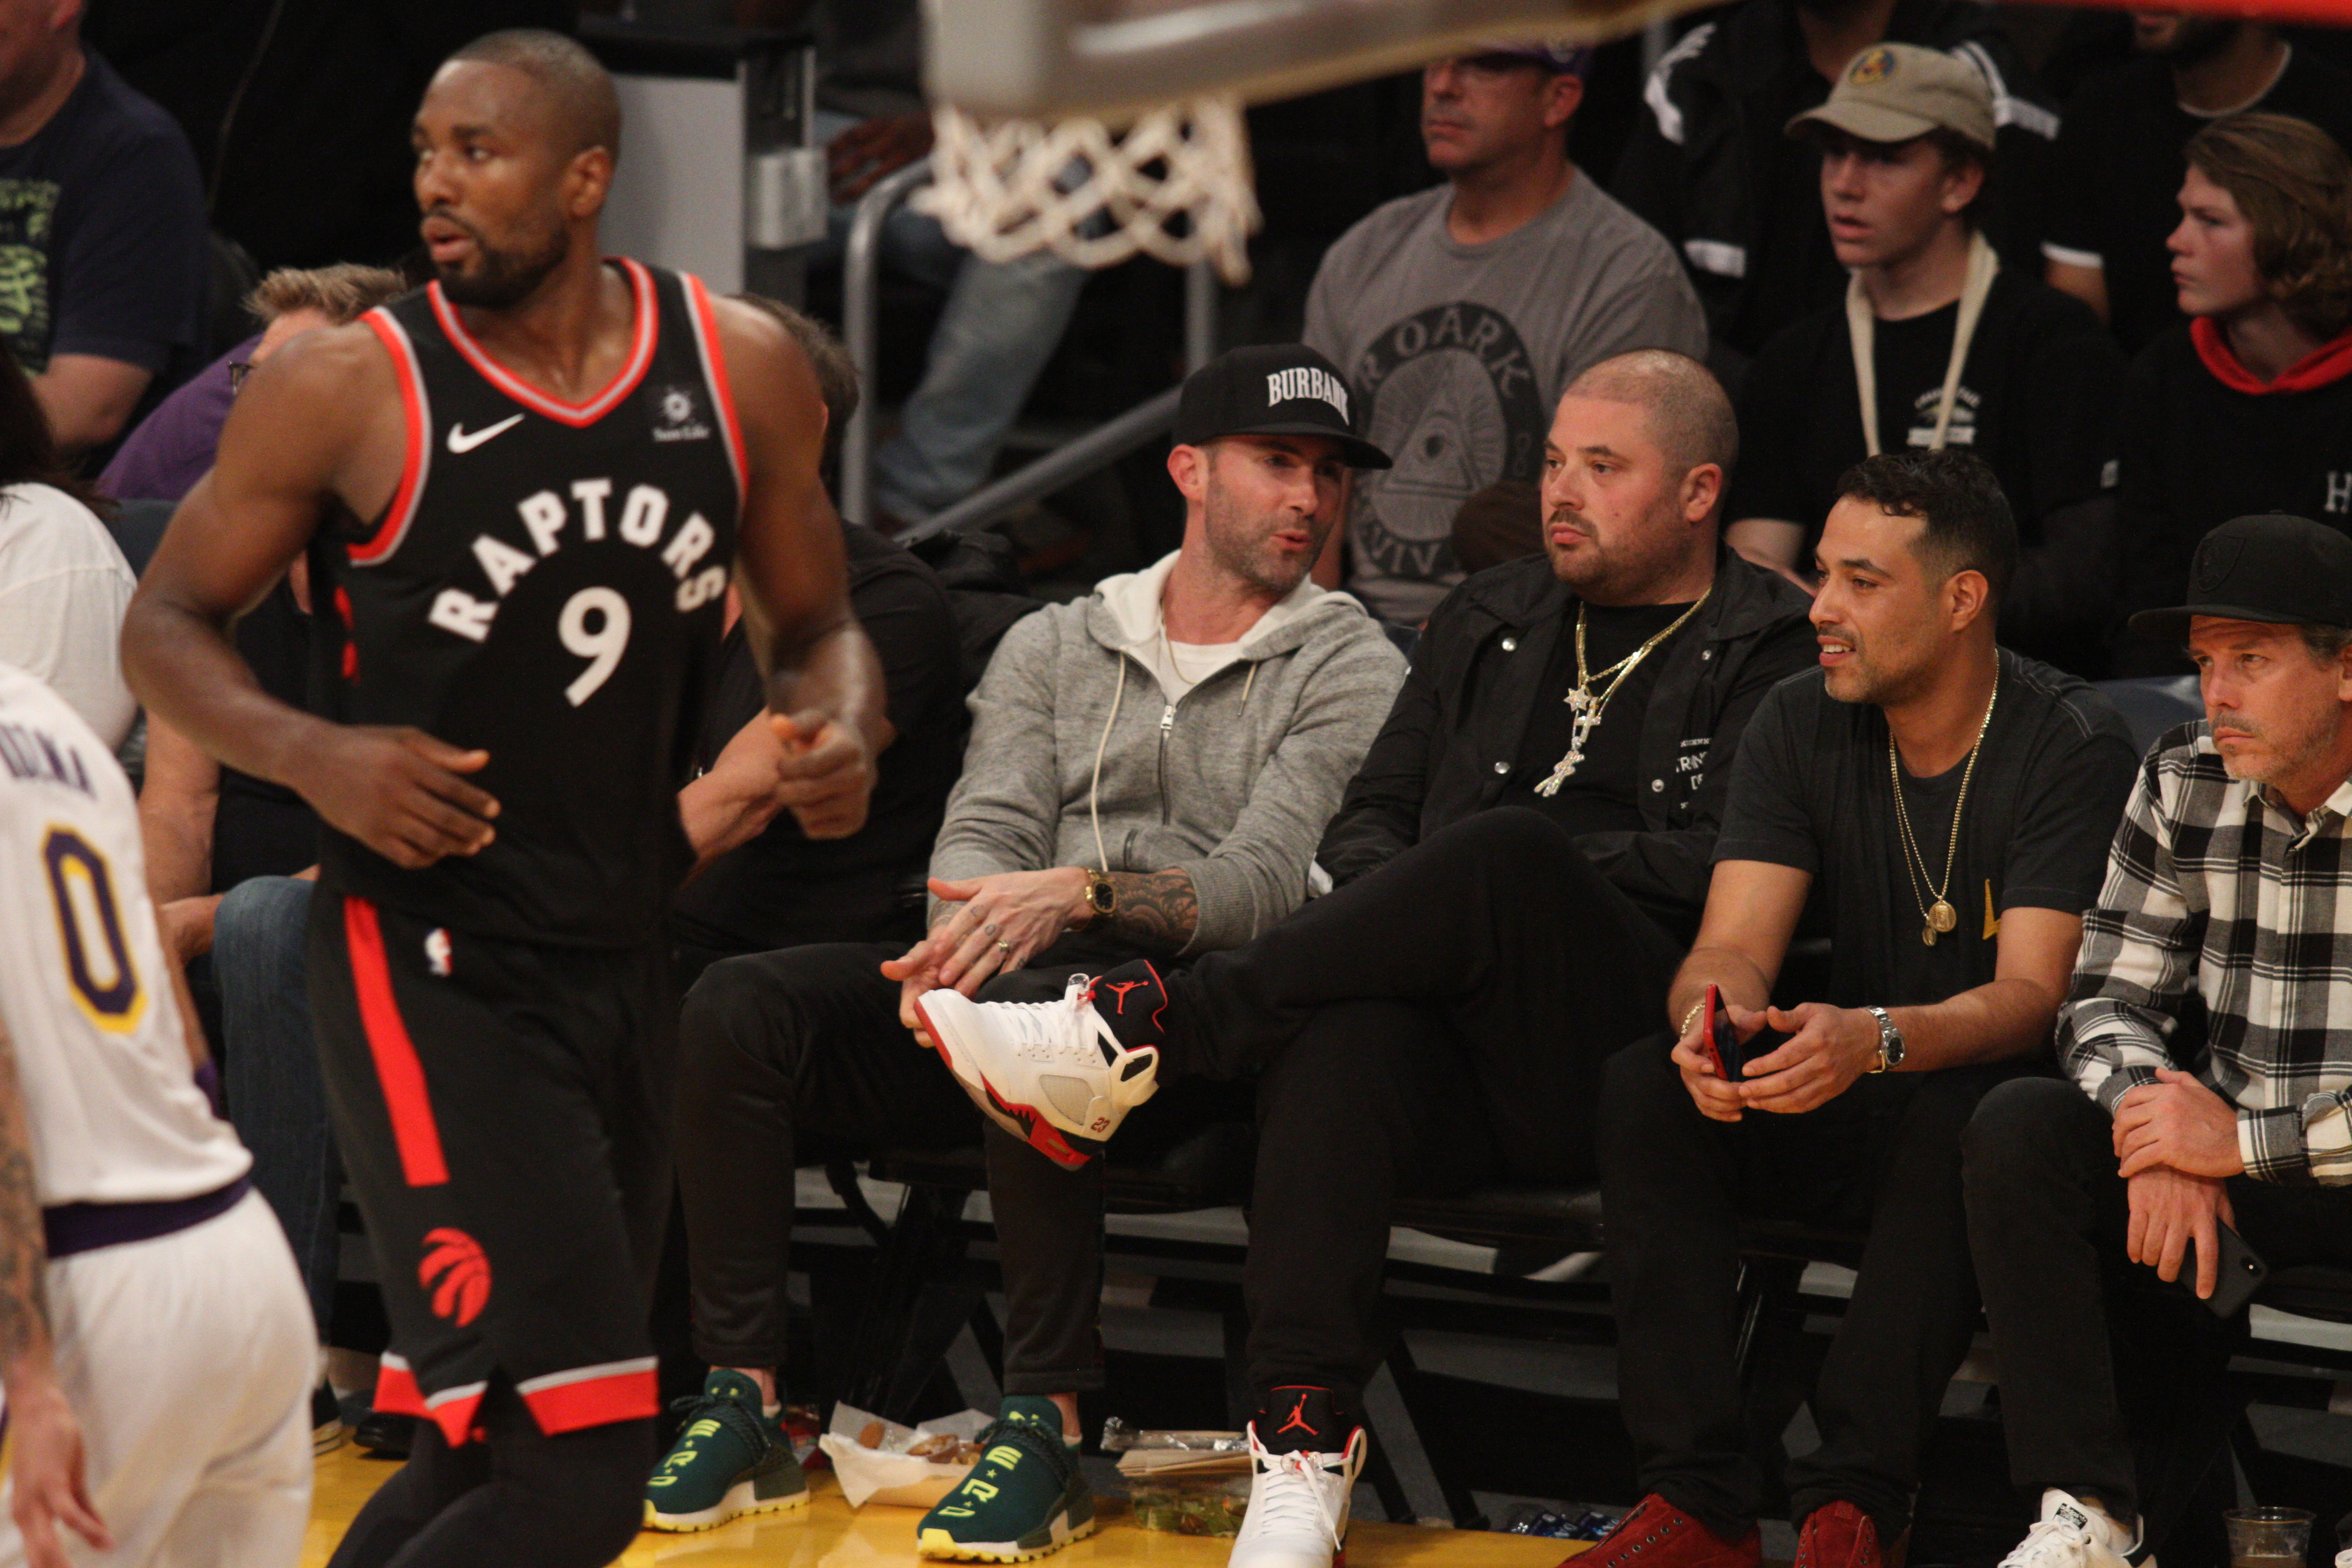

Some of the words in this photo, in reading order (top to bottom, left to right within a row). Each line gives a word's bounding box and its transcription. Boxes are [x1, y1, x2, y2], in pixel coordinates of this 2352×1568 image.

[427, 476, 727, 643] RAPTORS
[558, 586, 632, 708] 9
[40, 819, 148, 1034] 0
[1090, 1116, 1111, 1133] 23
